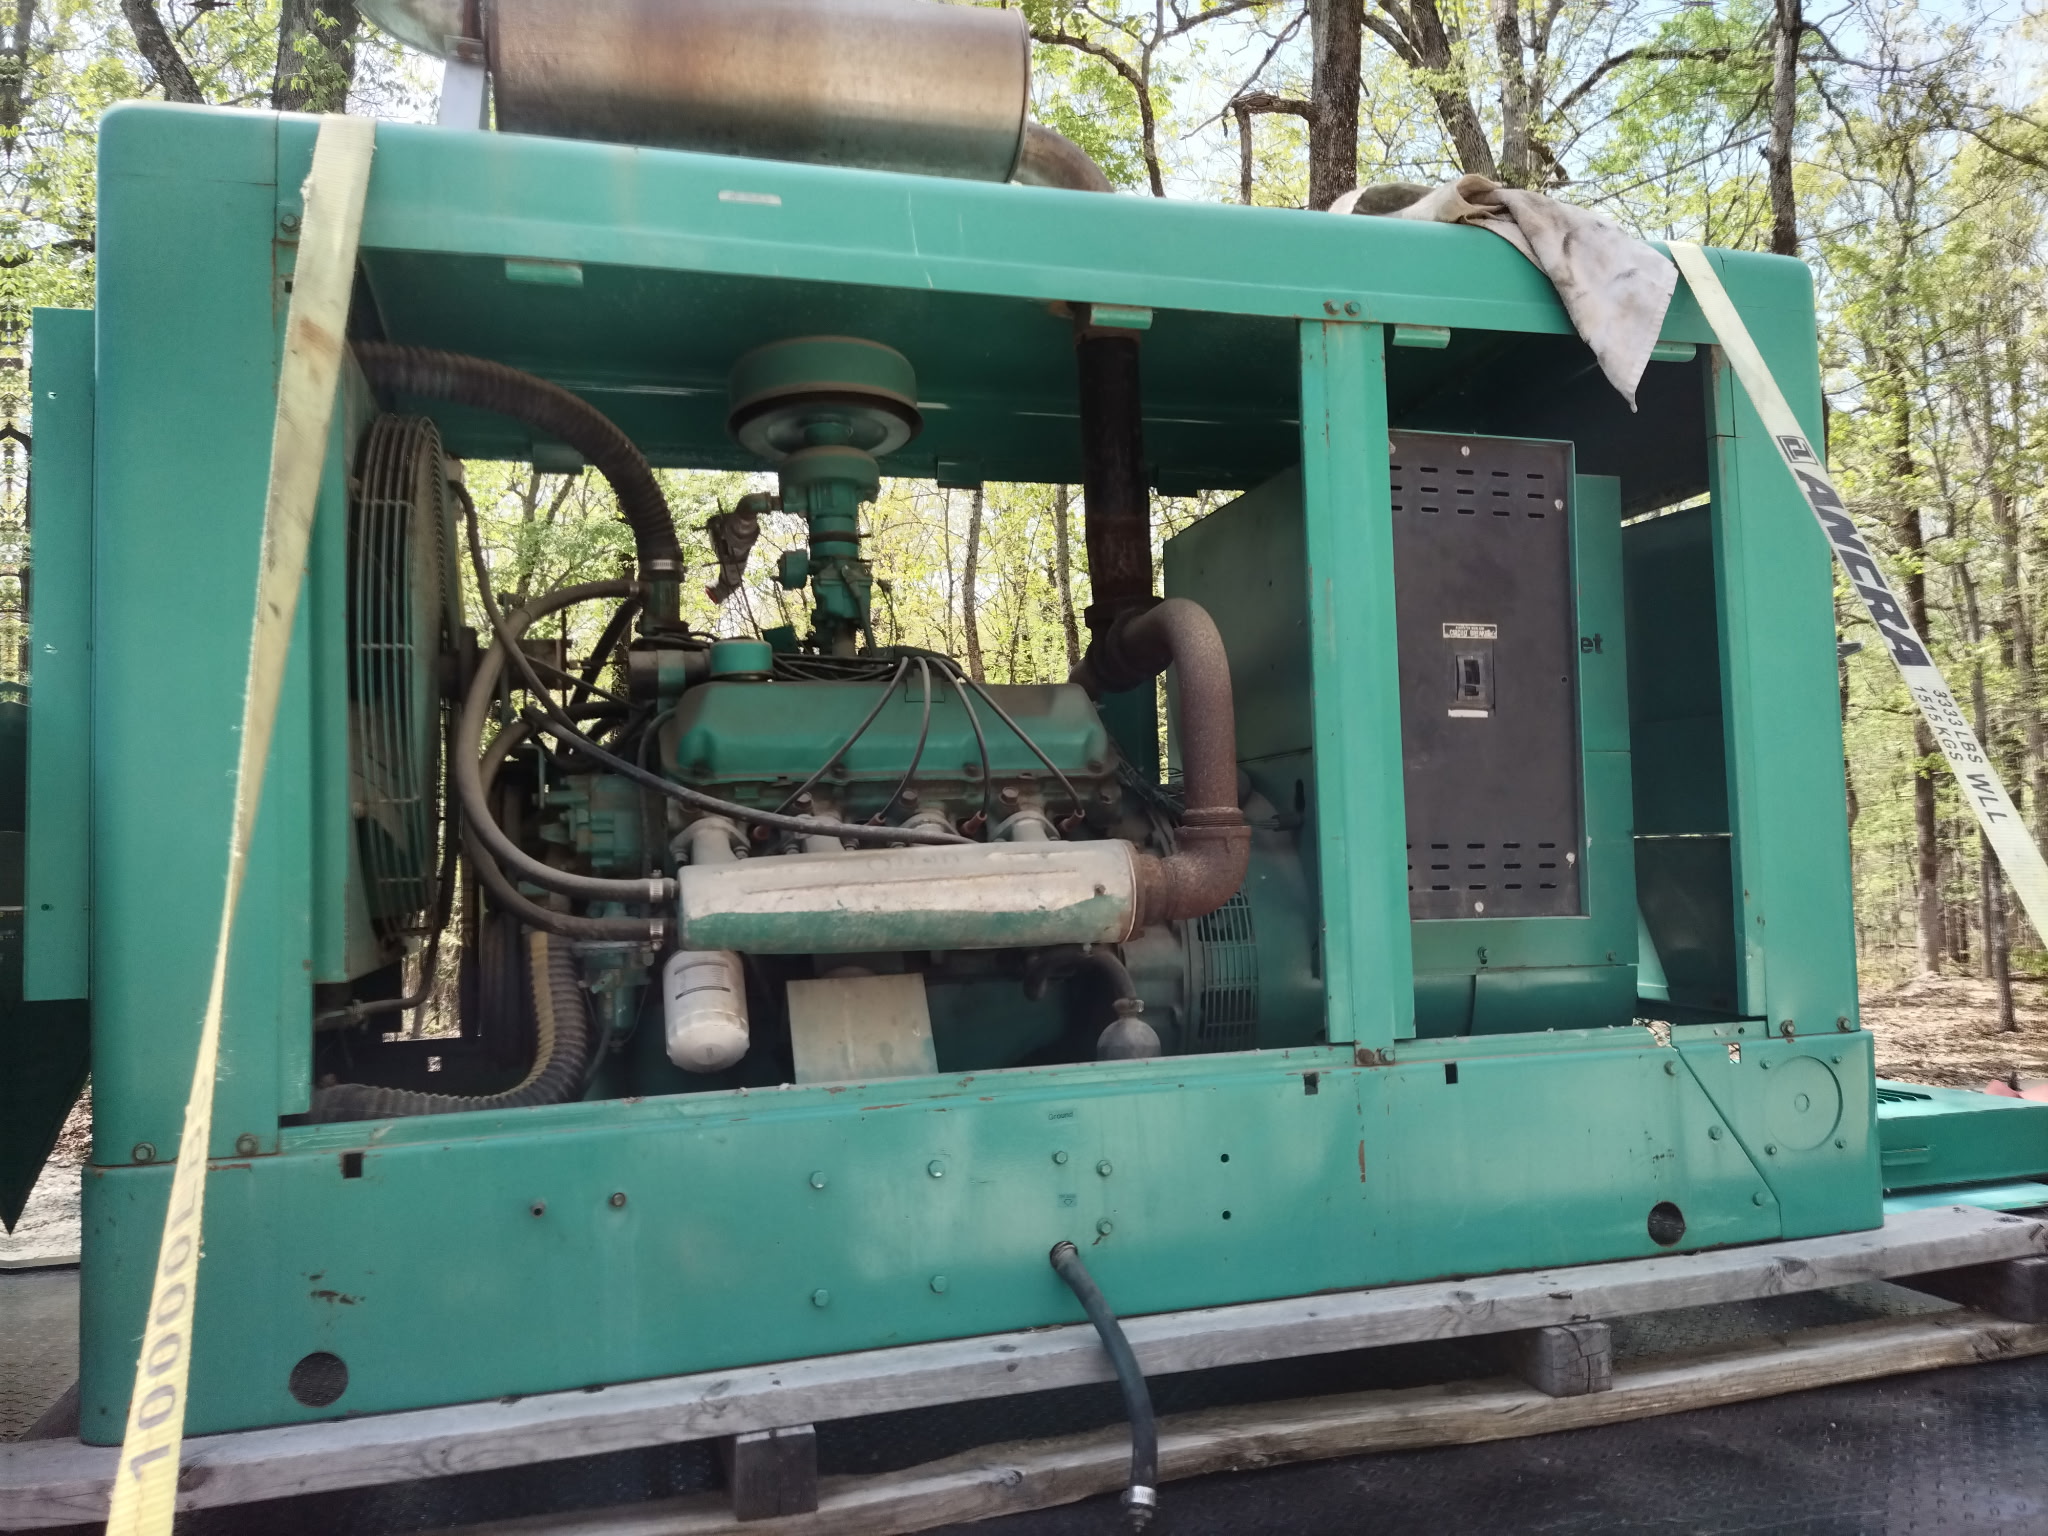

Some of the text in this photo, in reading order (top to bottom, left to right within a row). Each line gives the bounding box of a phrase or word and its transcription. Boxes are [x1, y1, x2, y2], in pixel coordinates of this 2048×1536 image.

[1794, 468, 1932, 667] ANCRA
[1914, 686, 1964, 762] 1515 KGS
[1932, 688, 2008, 824] 3333 LBS WLL
